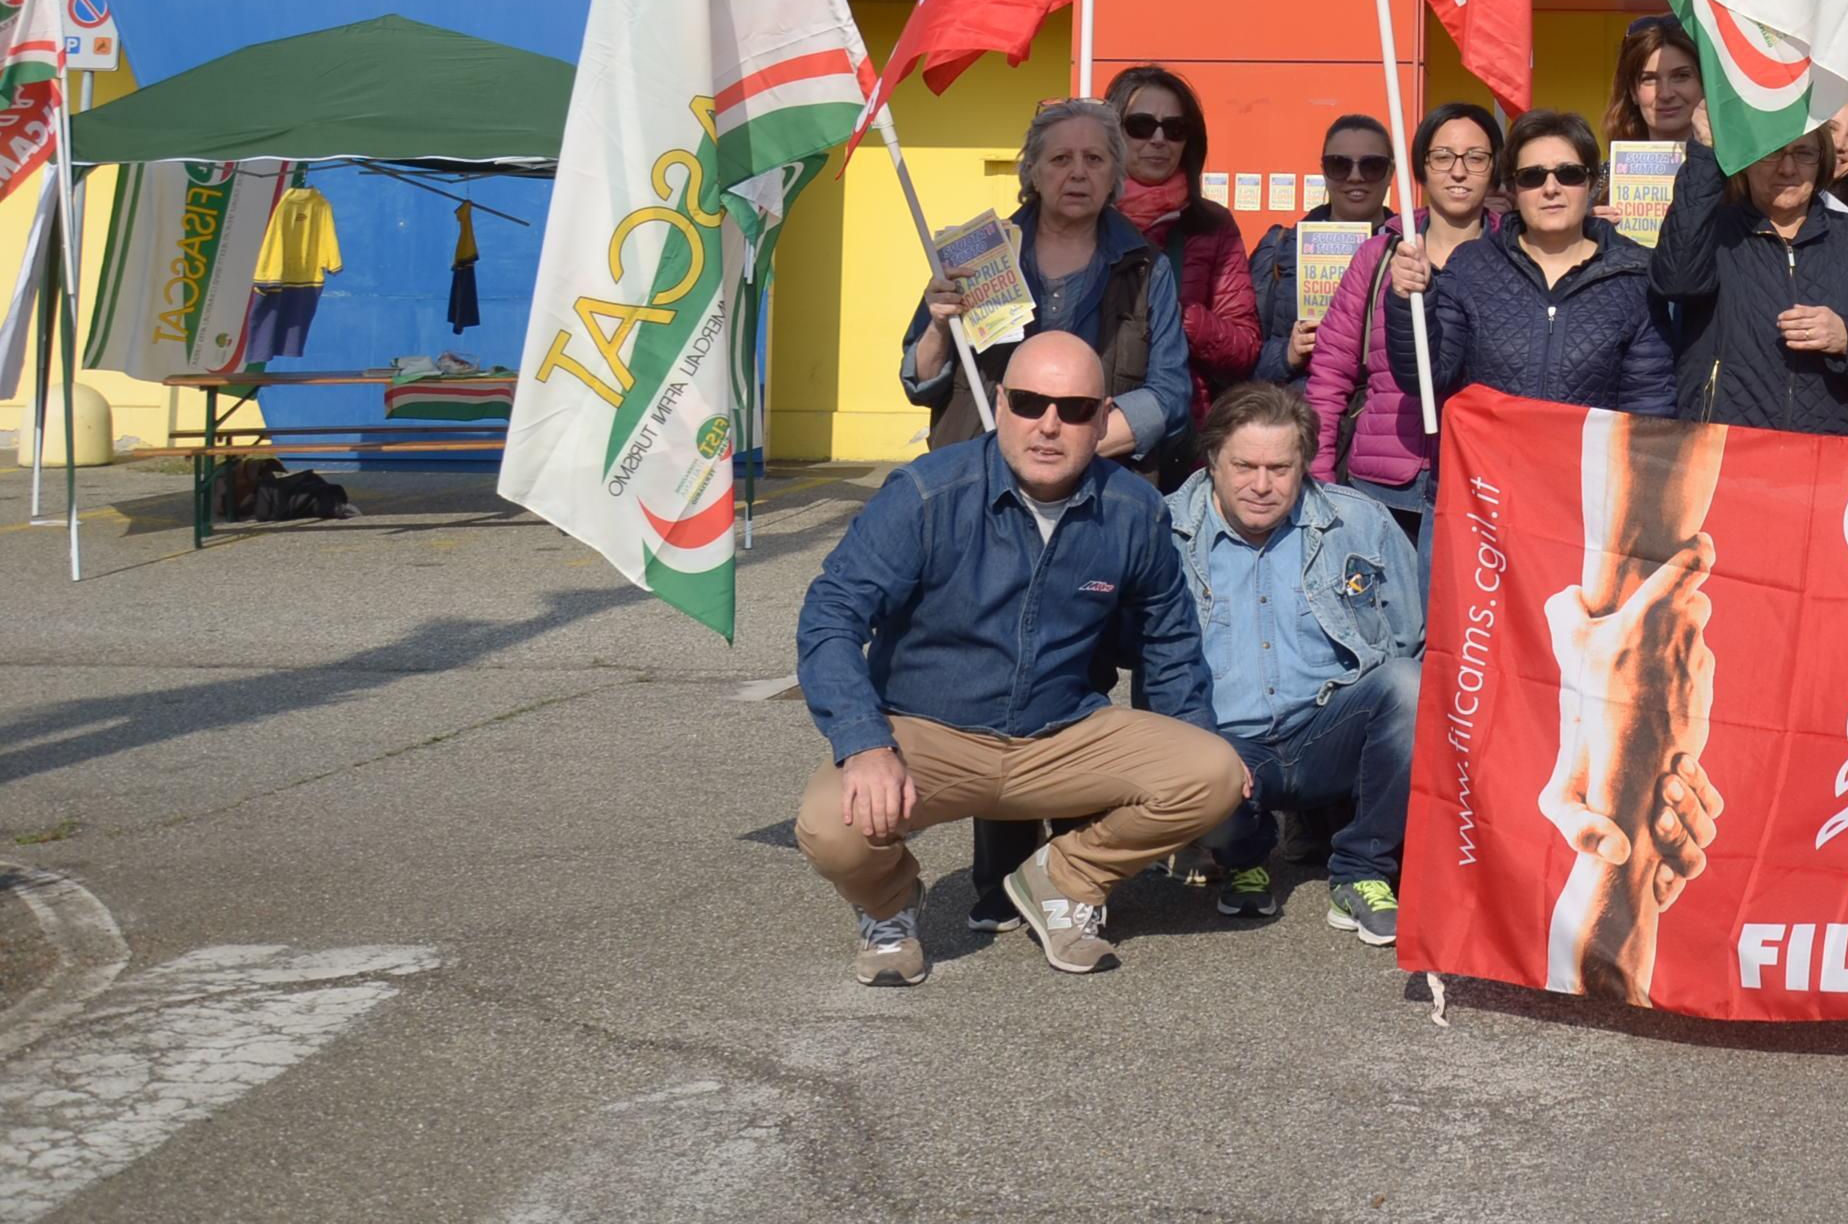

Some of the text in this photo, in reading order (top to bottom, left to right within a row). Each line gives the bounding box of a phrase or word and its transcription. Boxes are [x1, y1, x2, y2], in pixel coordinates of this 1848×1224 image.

[1617, 186, 1671, 201] 18 APRIL
[1303, 265, 1316, 279] 18
[1447, 476, 1507, 866] www.filcams.cgil.it
